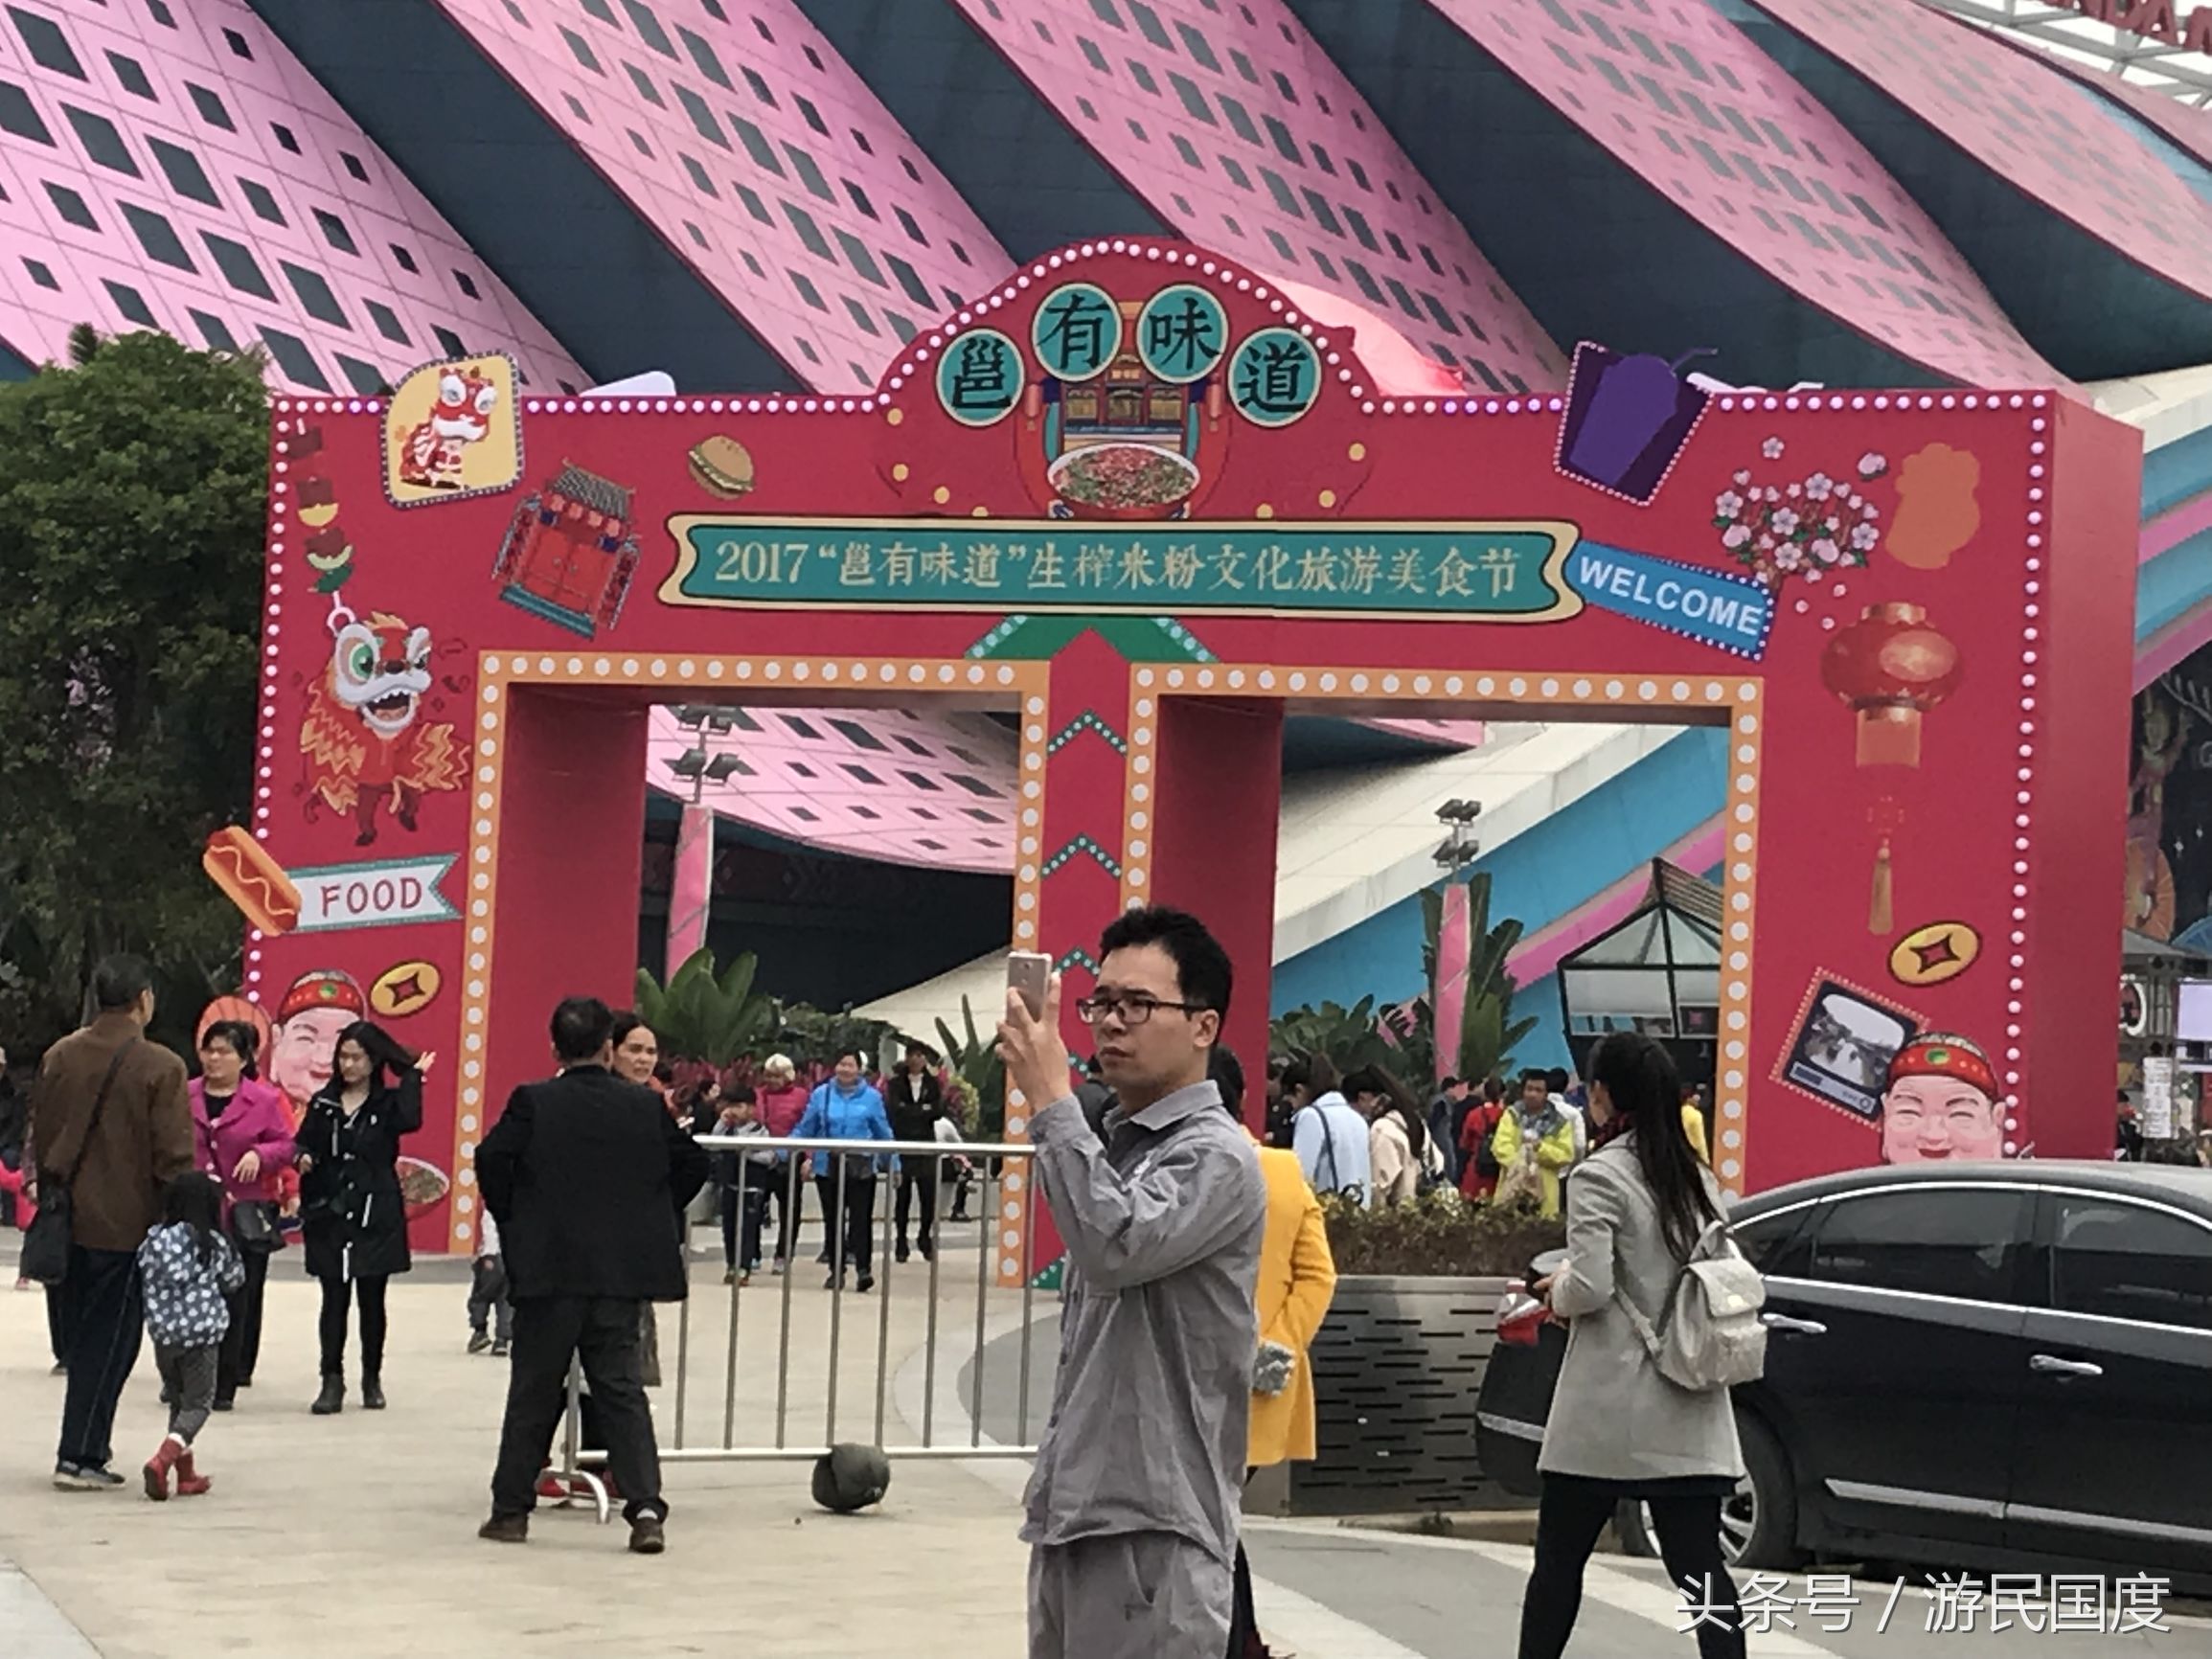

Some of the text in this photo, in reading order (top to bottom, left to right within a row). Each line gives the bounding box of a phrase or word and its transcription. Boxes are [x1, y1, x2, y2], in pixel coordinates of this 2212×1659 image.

[951, 293, 1311, 413] 邕有味道
[1580, 556, 1765, 636] WELCOME
[321, 876, 422, 917] FOOD
